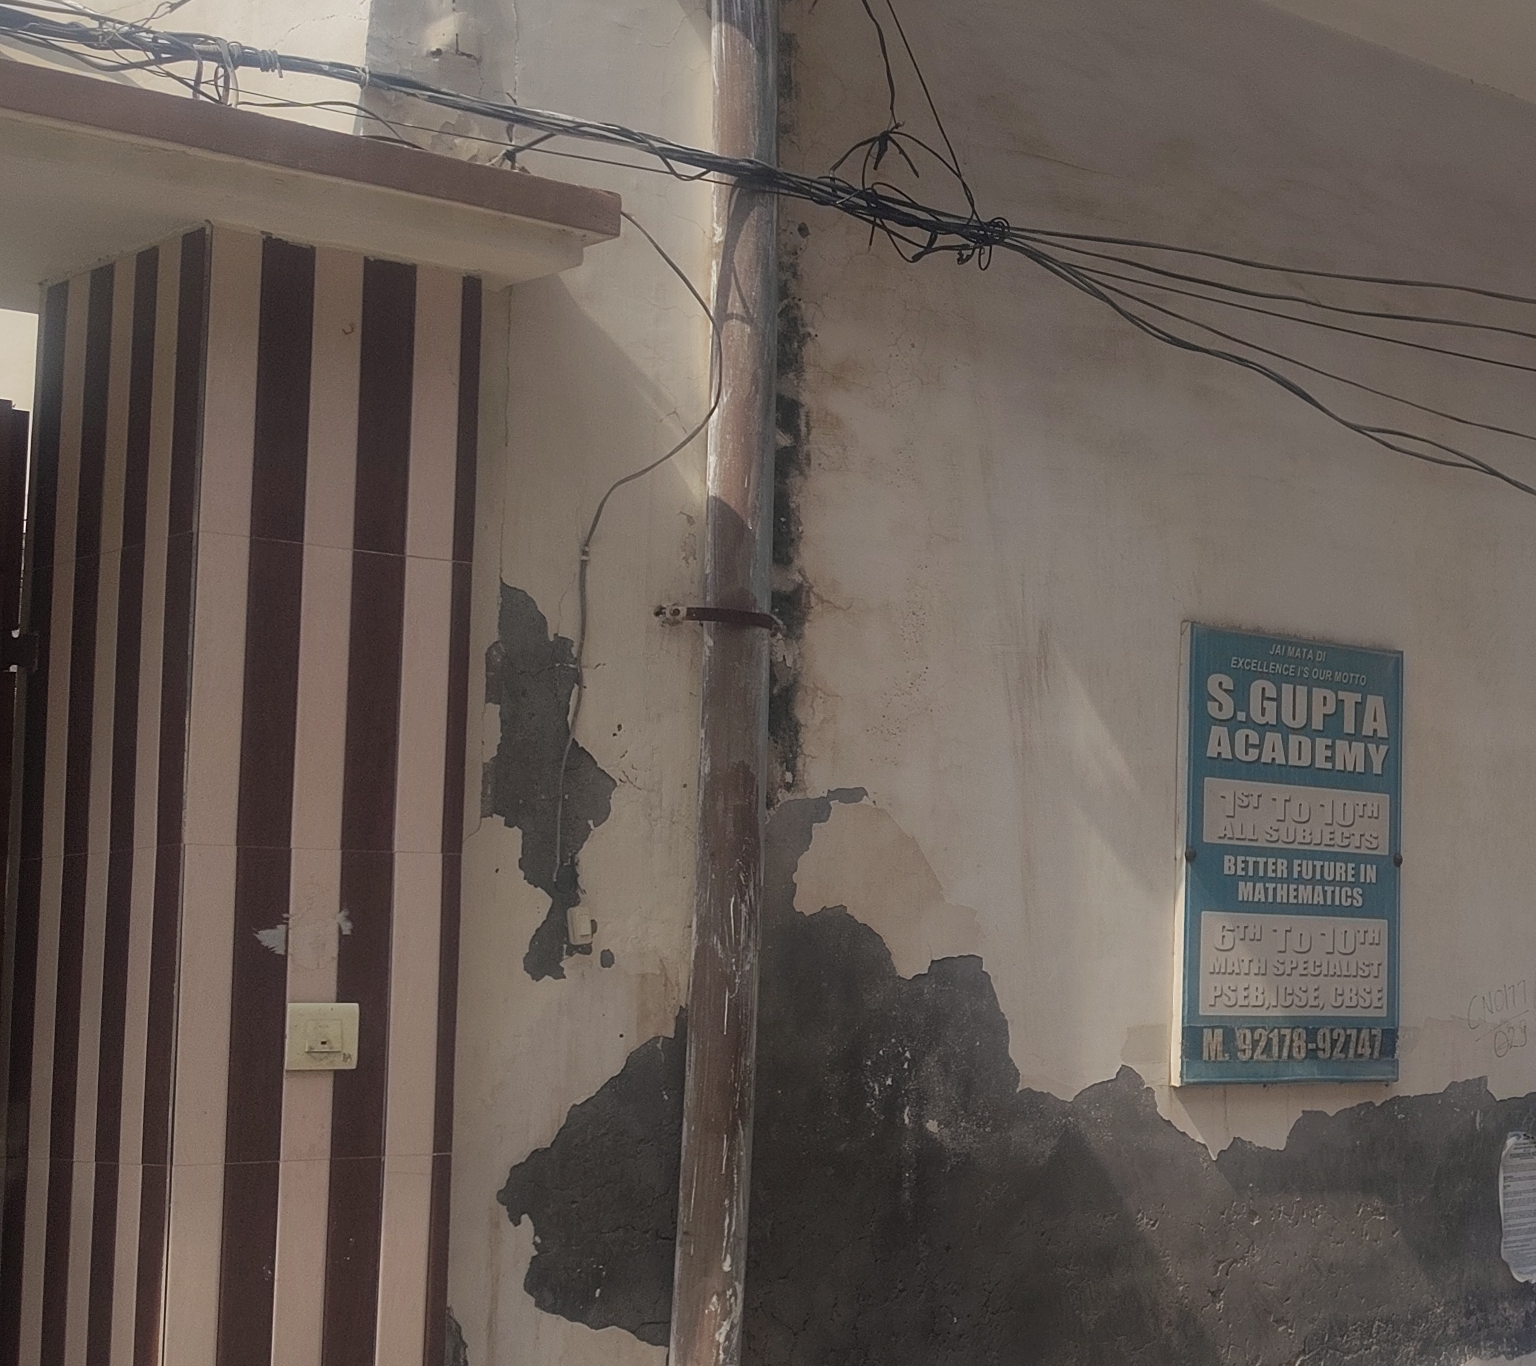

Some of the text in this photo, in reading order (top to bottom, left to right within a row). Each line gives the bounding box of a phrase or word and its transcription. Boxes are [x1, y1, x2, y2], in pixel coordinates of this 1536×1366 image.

[1269, 643, 1326, 662] JAI MATA DI
[1230, 657, 1296, 676] EXCELLENCE
[1312, 669, 1333, 681] OUR
[1334, 671, 1367, 686] MOTTO
[1206, 673, 1389, 739] S.GUPTA
[1206, 725, 1390, 775] ACADEMY
[1218, 820, 1380, 851] ALL SUBJECTS
[1223, 854, 1377, 884] BETTER FUTURE IN
[1237, 881, 1363, 907] MATHEMATICS
[1209, 956, 1383, 979] MATH SPECIALIST
[1330, 986, 1384, 1010] CBSE
[1236, 1026, 1383, 1061] 92178-92747
